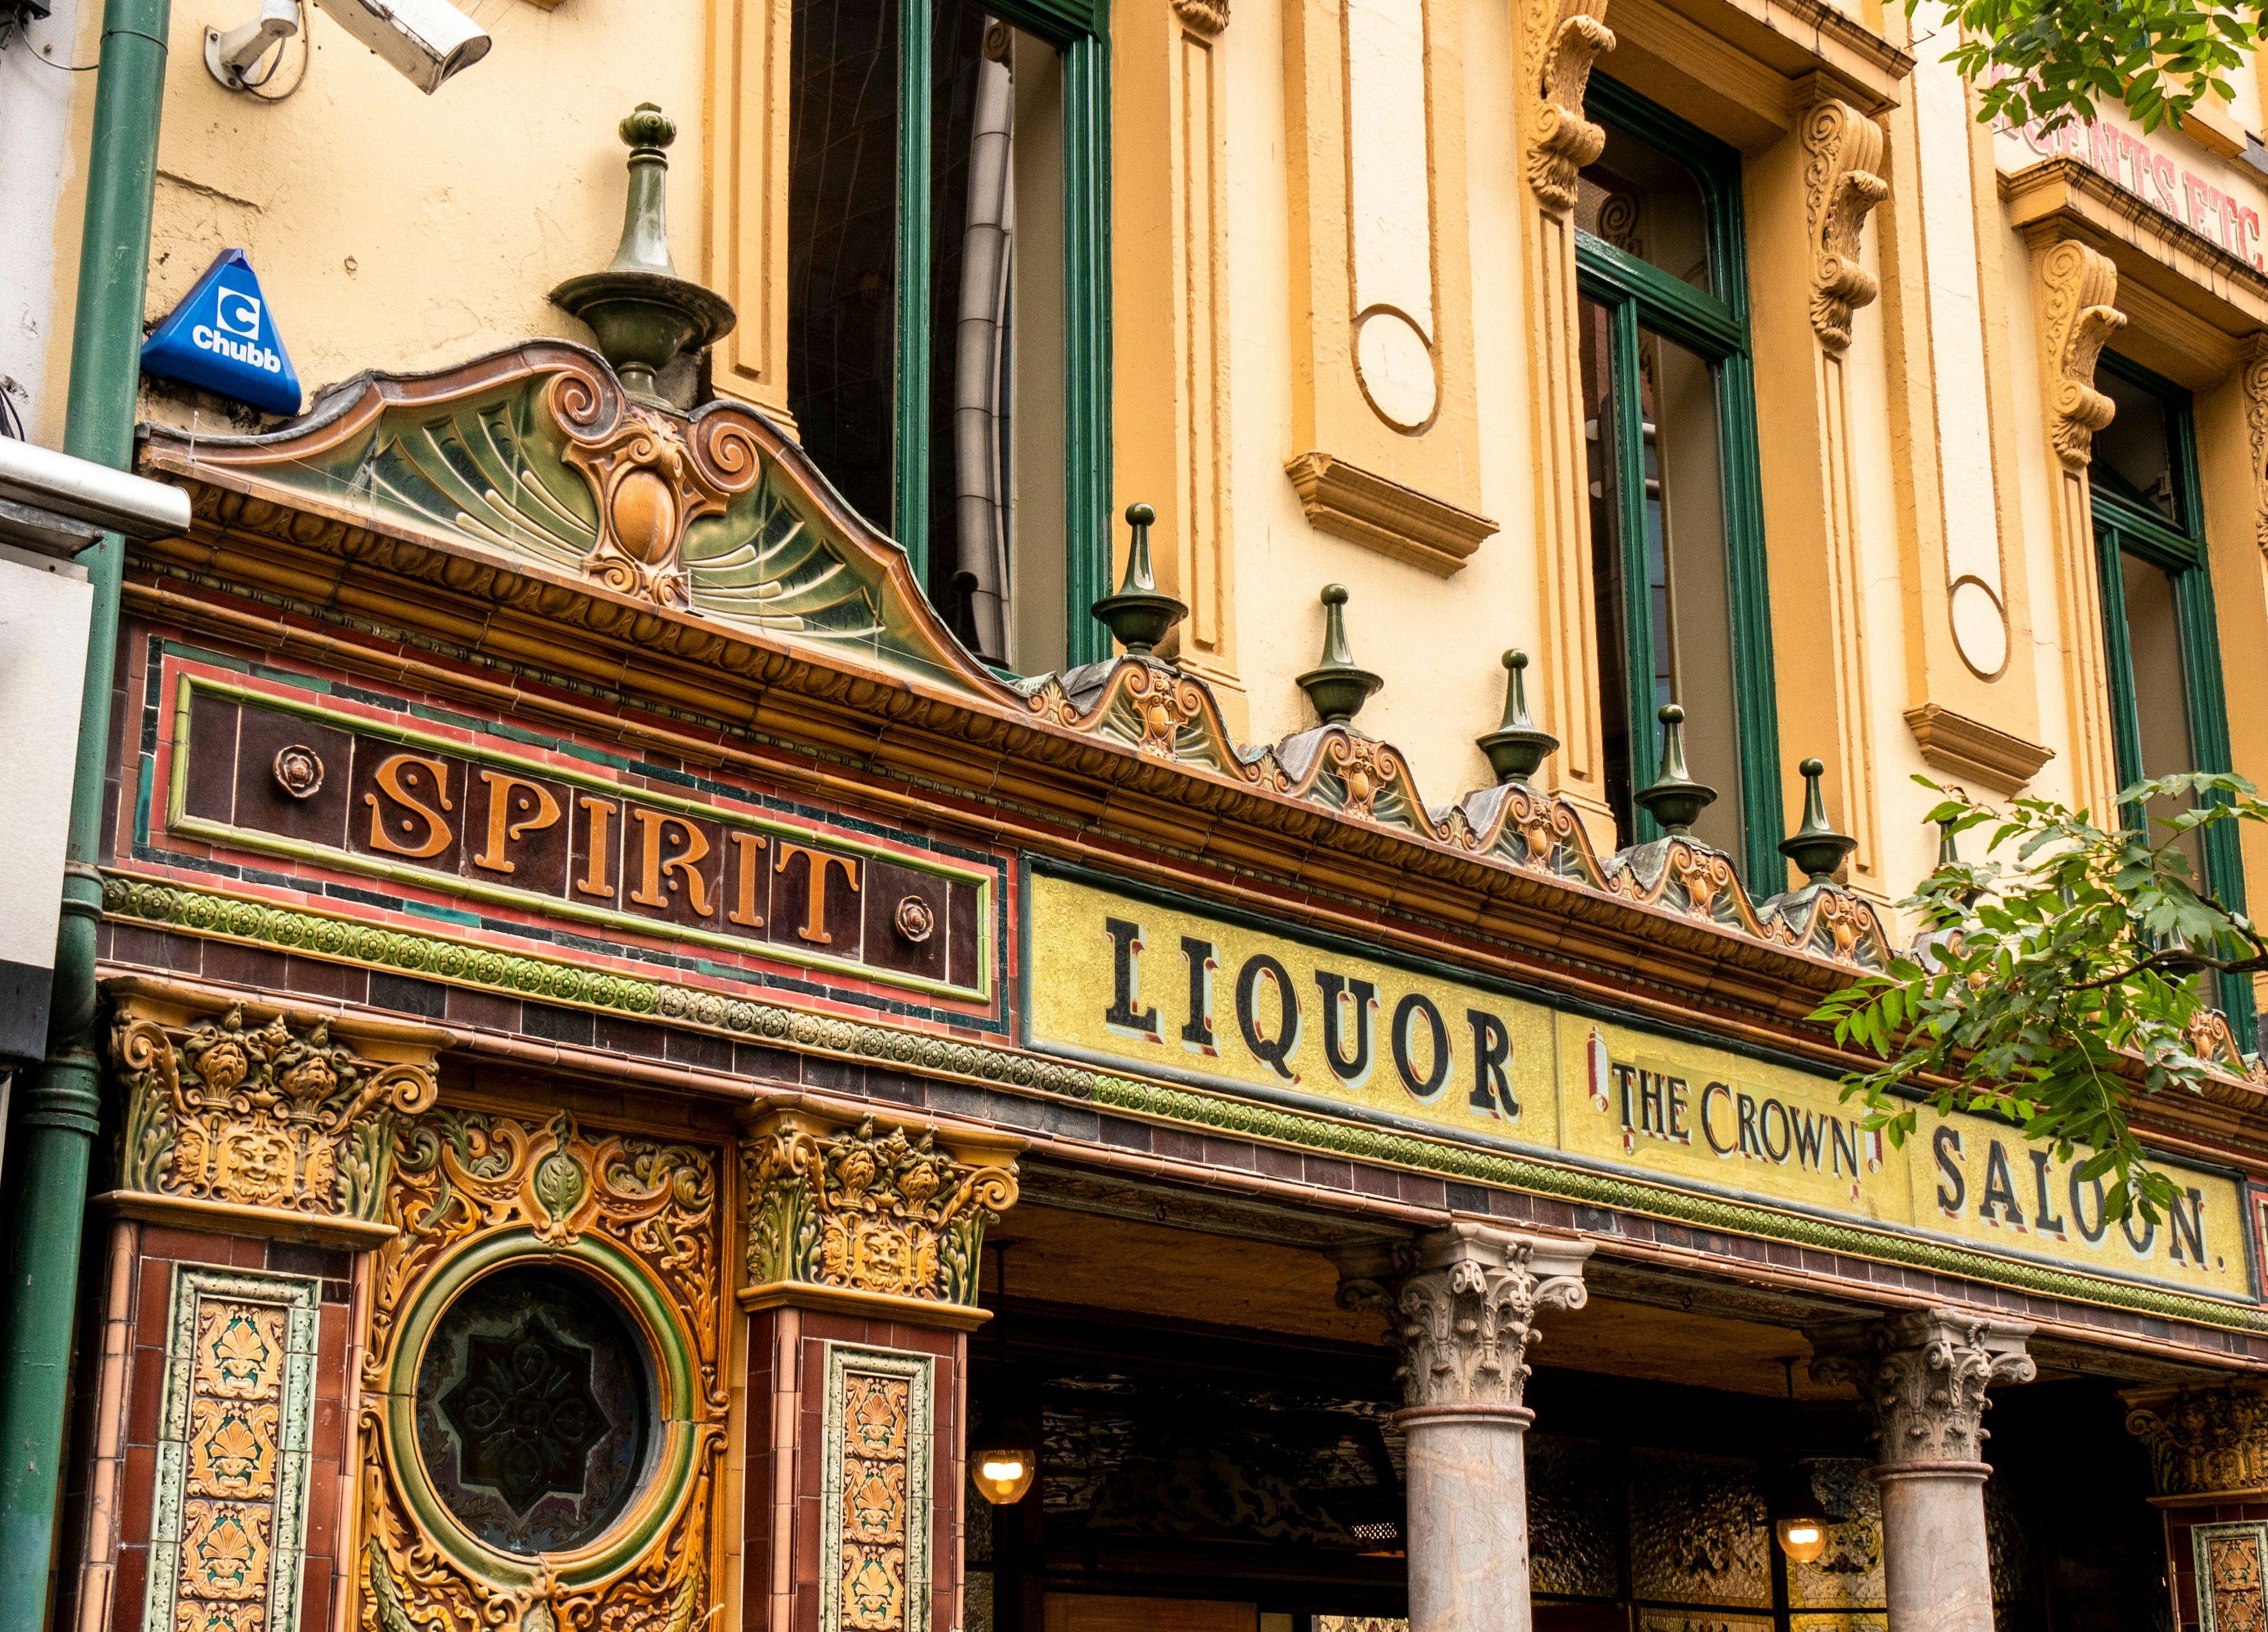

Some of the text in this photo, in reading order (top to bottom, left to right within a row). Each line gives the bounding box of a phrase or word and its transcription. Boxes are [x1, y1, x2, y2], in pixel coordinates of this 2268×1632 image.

[192, 324, 281, 373] Chubb
[220, 294, 256, 332] C
[364, 753, 860, 944] SPIRIT
[1105, 916, 1524, 1123] LIQUOR
[1611, 1062, 1861, 1183] THE CROWN
